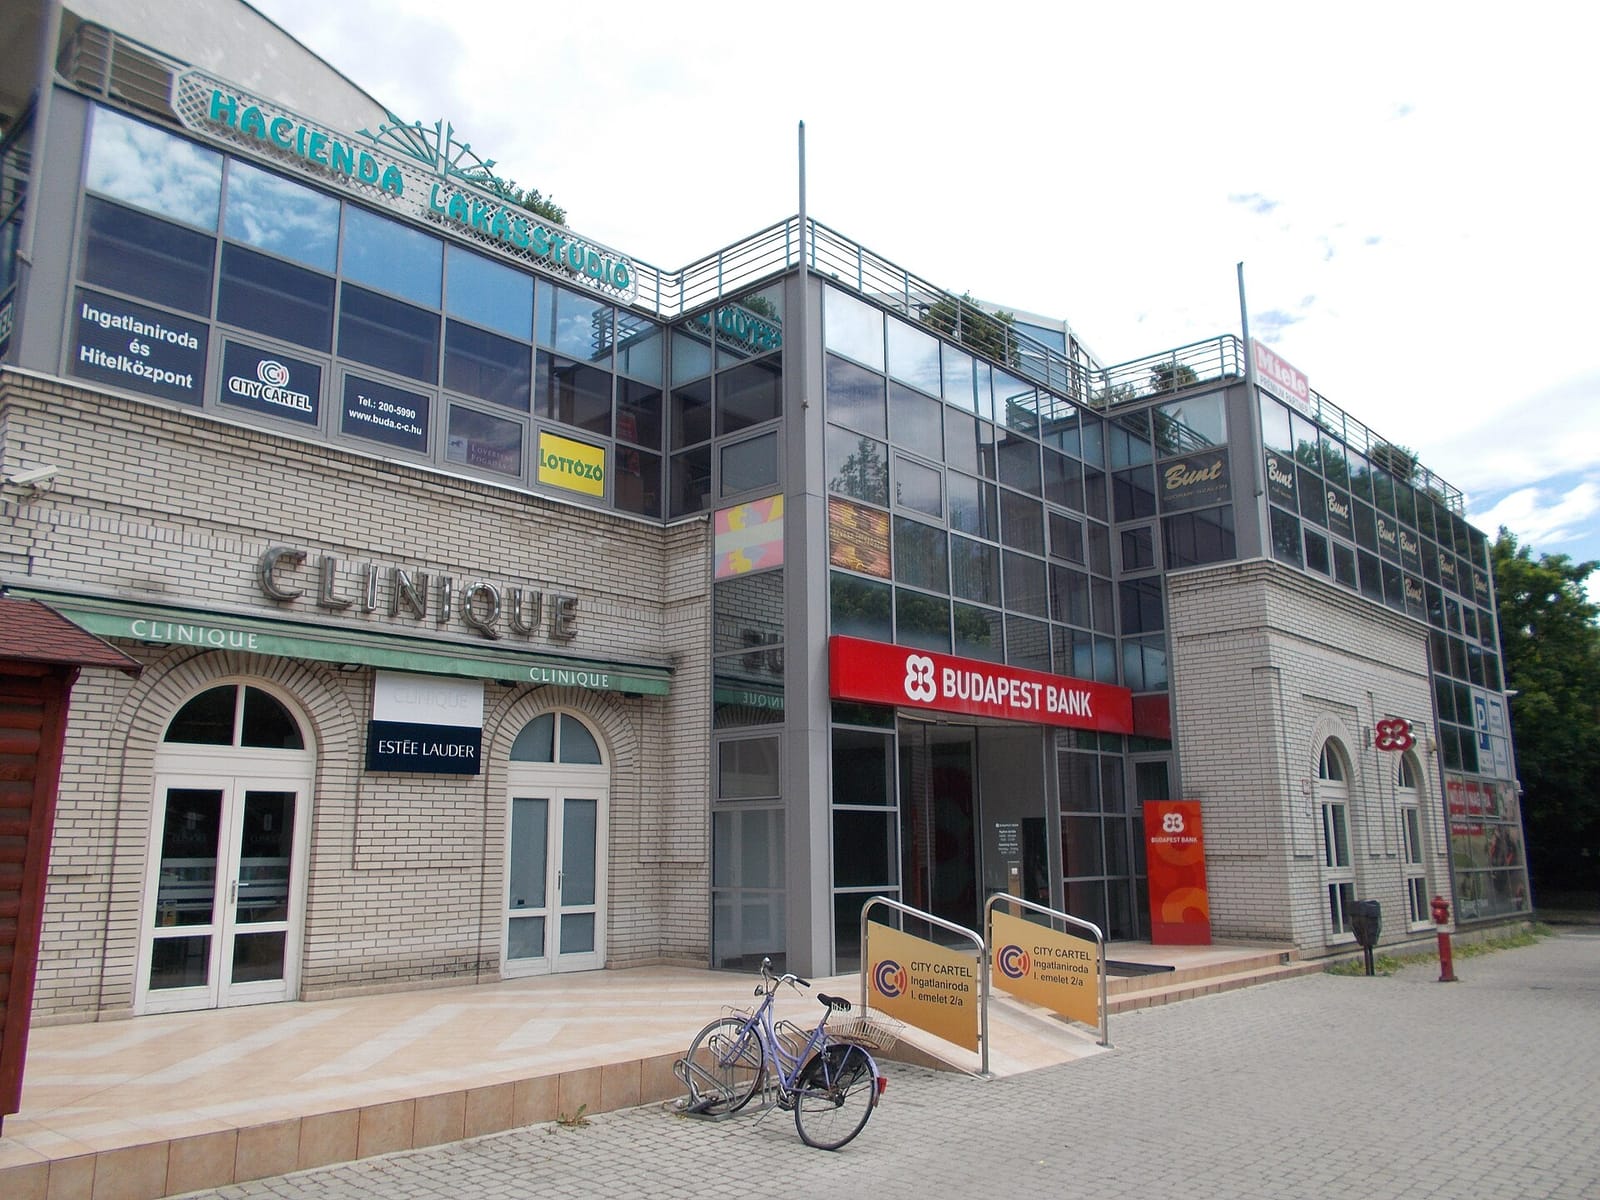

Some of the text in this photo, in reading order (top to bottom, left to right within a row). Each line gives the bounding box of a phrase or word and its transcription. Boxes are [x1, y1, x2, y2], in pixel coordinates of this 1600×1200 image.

[209, 89, 404, 196] HACIENDA
[82, 303, 199, 351] Ingatlaniroda
[129, 338, 150, 357] és
[79, 345, 193, 389] Hitelközpont
[1256, 346, 1307, 398] Miele
[229, 377, 312, 411] CITY CARTEL
[358, 395, 416, 420] Tel.: 200-5990
[348, 408, 422, 435] www.buda.c-c.hu
[540, 448, 603, 481] LOTTÓZÓ
[1164, 459, 1222, 490] Bunt
[1267, 458, 1293, 488] Bunt
[1327, 491, 1349, 519] Bunt
[1377, 519, 1396, 544] Bunt
[1400, 531, 1417, 555] Bunt
[256, 545, 579, 641] CLINIQUE
[131, 619, 259, 649] CLINIQUE
[529, 667, 609, 687] CLINIQUE
[943, 667, 1093, 718] BUDAPEST BANK
[422, 742, 475, 758] LAUDER
[1033, 946, 1092, 961] CITY CARTEL
[1033, 959, 1089, 975] Ingatlaniroda
[910, 961, 973, 978] CITY CARTEL
[1040, 973, 1069, 985] emelet
[1071, 977, 1084, 987] 2/a
[911, 975, 969, 992] Ingatlaniroda
[918, 992, 948, 1004] emelet
[949, 996, 964, 1006] 2/a
